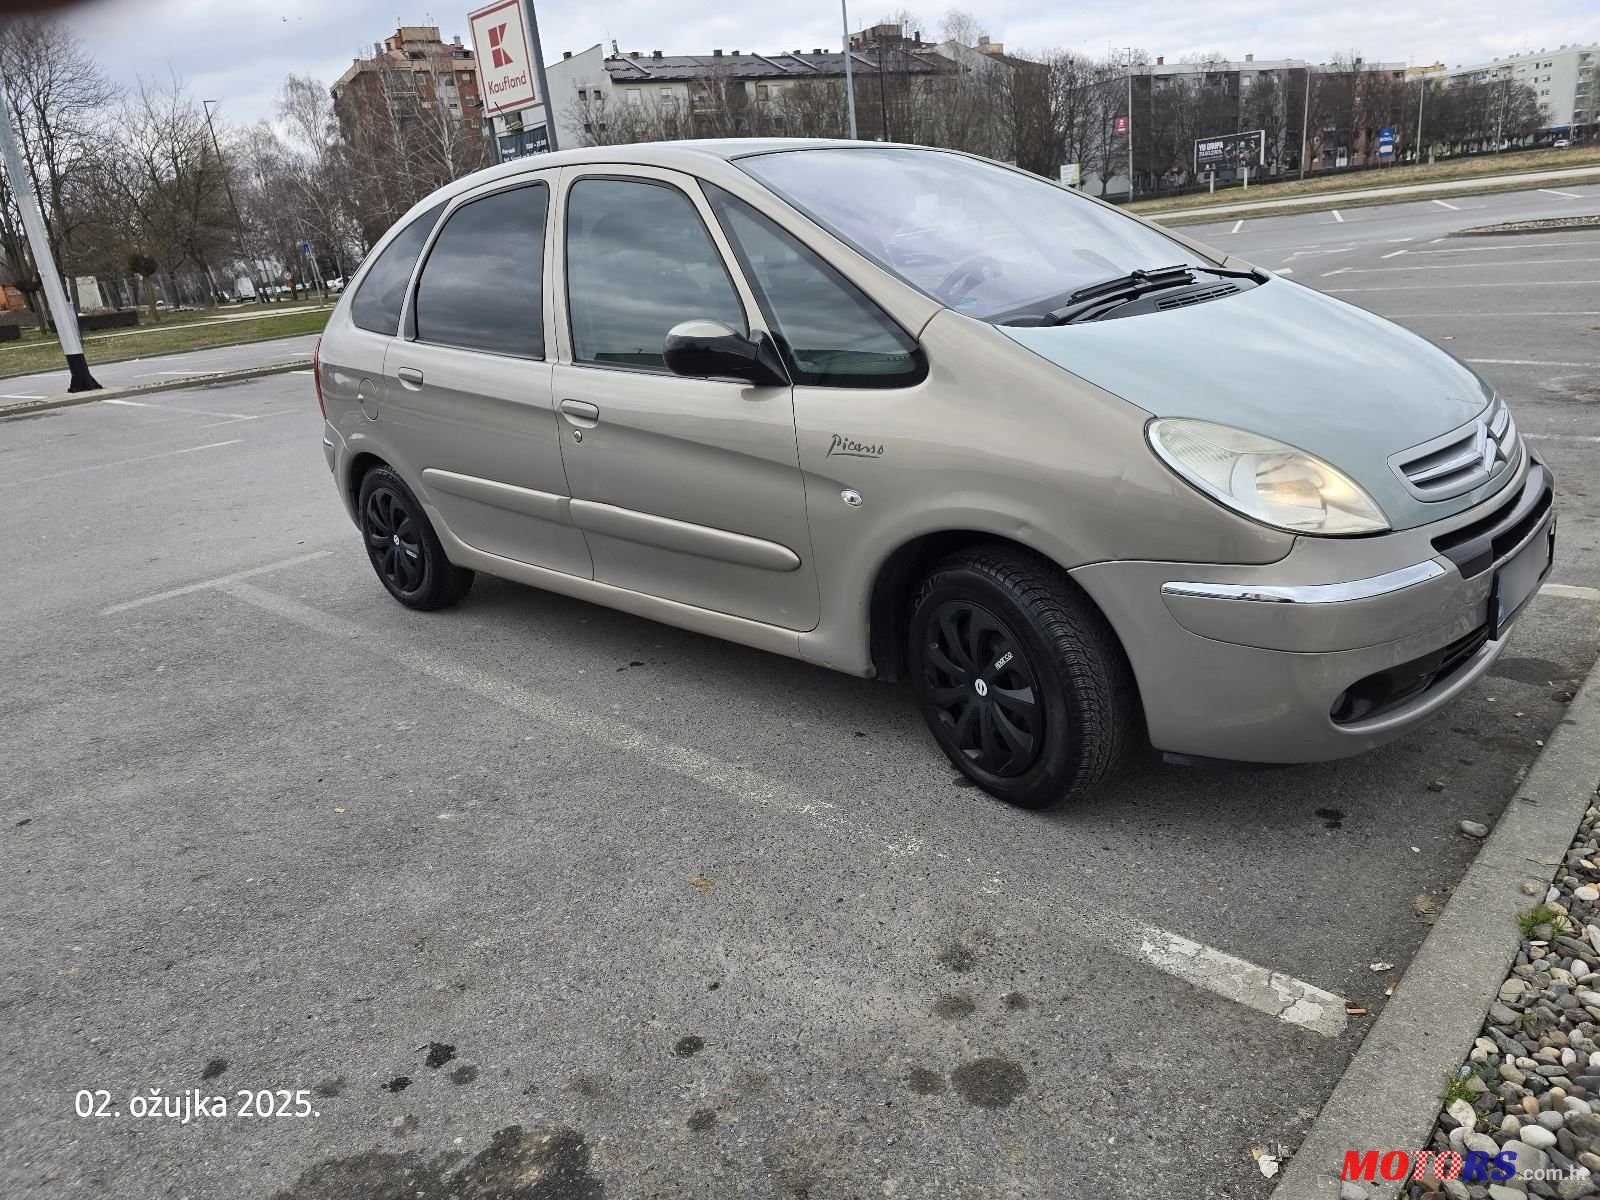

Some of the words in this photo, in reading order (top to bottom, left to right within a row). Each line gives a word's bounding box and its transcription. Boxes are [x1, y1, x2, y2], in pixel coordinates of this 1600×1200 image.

[488, 70, 527, 95] Kaufland
[1199, 143, 1207, 152] YU
[1207, 140, 1224, 151] GRUPA
[826, 433, 884, 458] Picasso
